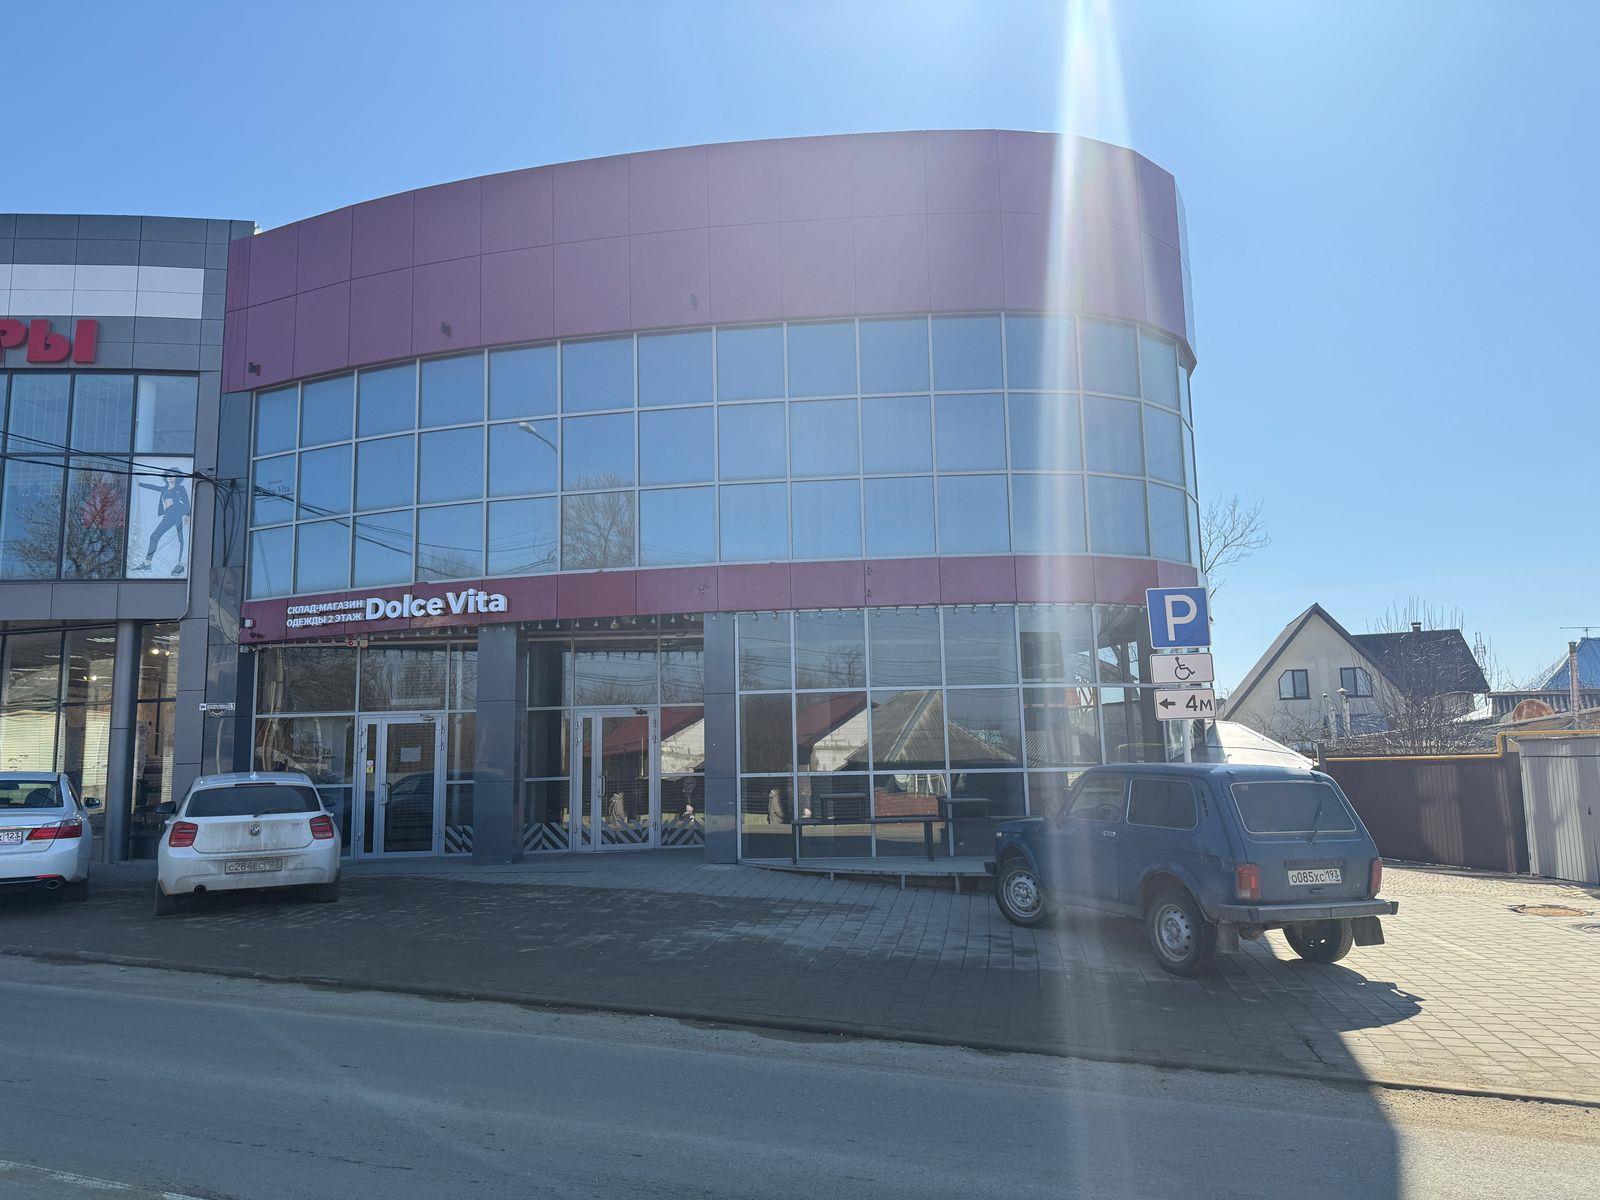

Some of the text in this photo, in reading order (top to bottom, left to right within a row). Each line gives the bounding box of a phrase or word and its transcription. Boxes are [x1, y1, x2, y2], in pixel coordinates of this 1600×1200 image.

[287, 600, 363, 614] СКЛАД-МАГАЗИН
[366, 588, 507, 620] Dolce Vita
[287, 613, 362, 628] ОДЕЖДЫ 2 ЭТАЖ
[1164, 594, 1198, 641] P
